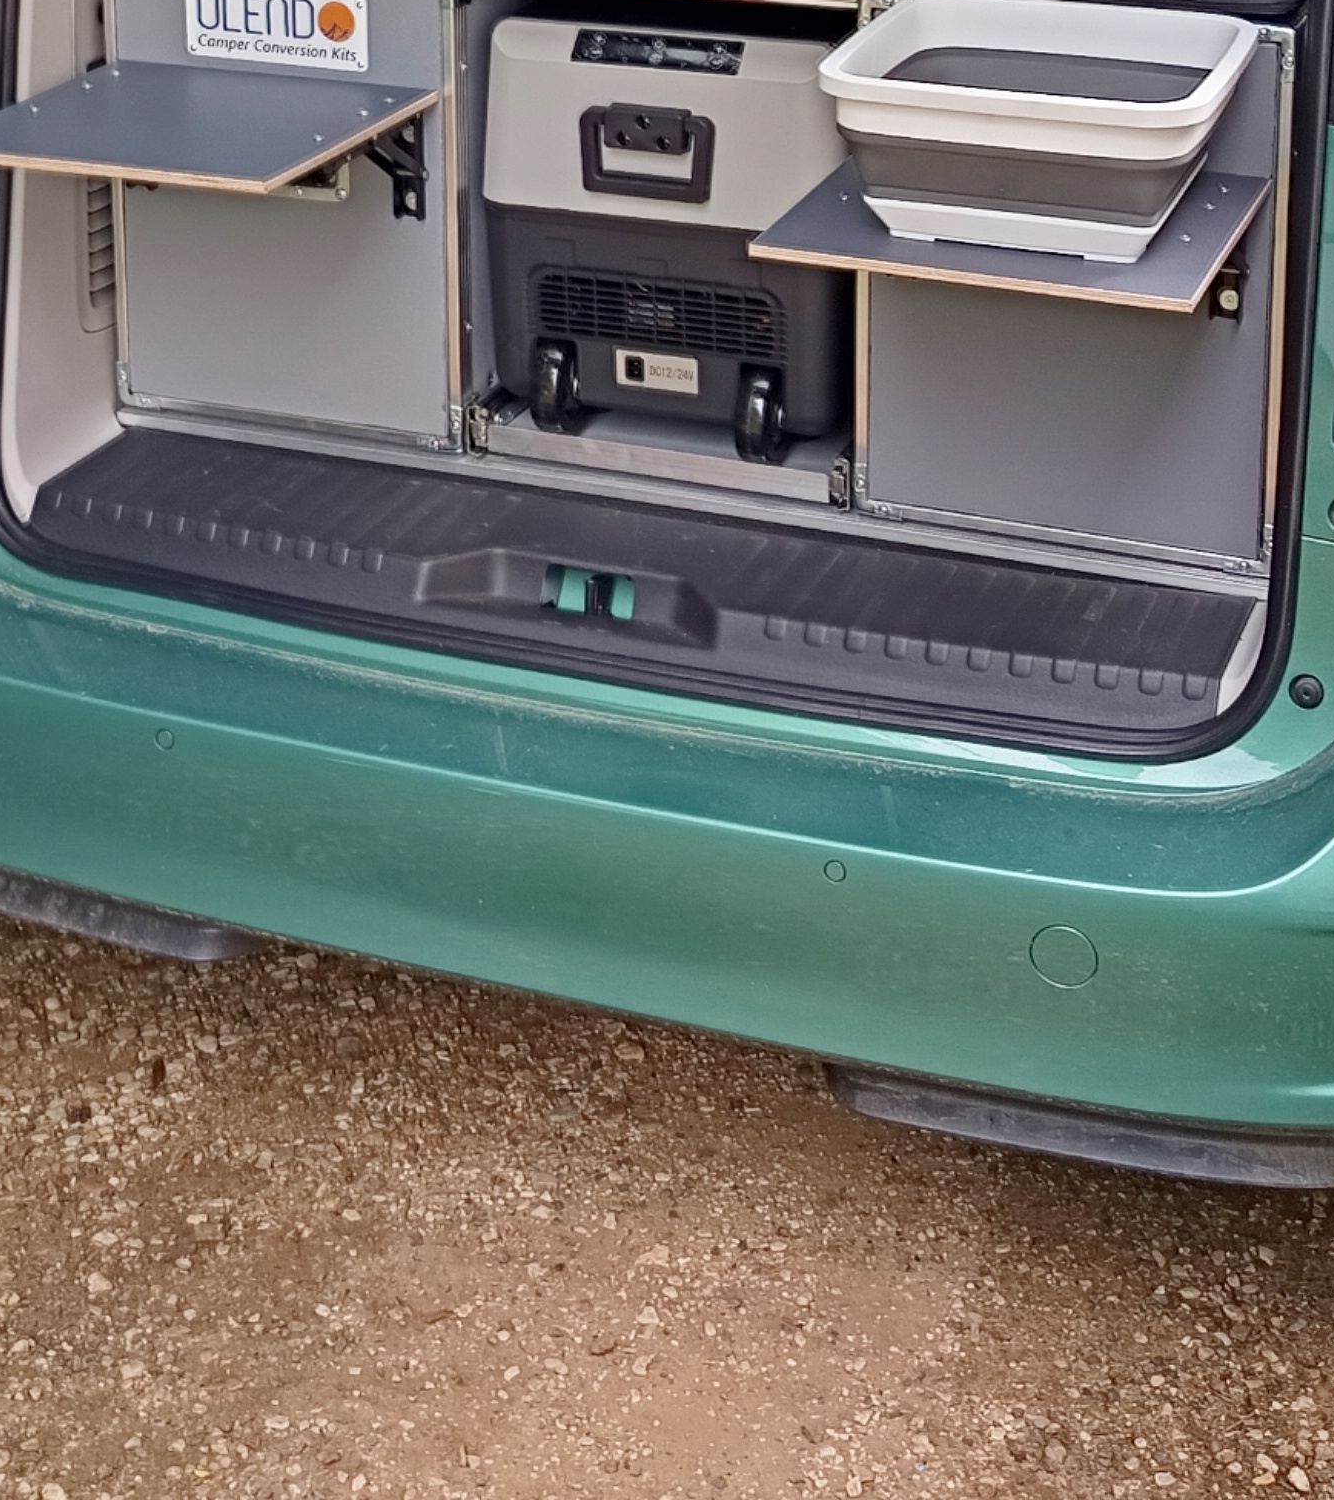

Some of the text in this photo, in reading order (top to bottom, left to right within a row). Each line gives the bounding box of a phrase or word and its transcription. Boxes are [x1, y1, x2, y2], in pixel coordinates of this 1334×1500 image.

[198, 34, 357, 62] Camper Conversion Kits
[649, 365, 694, 381] DC12/24V
